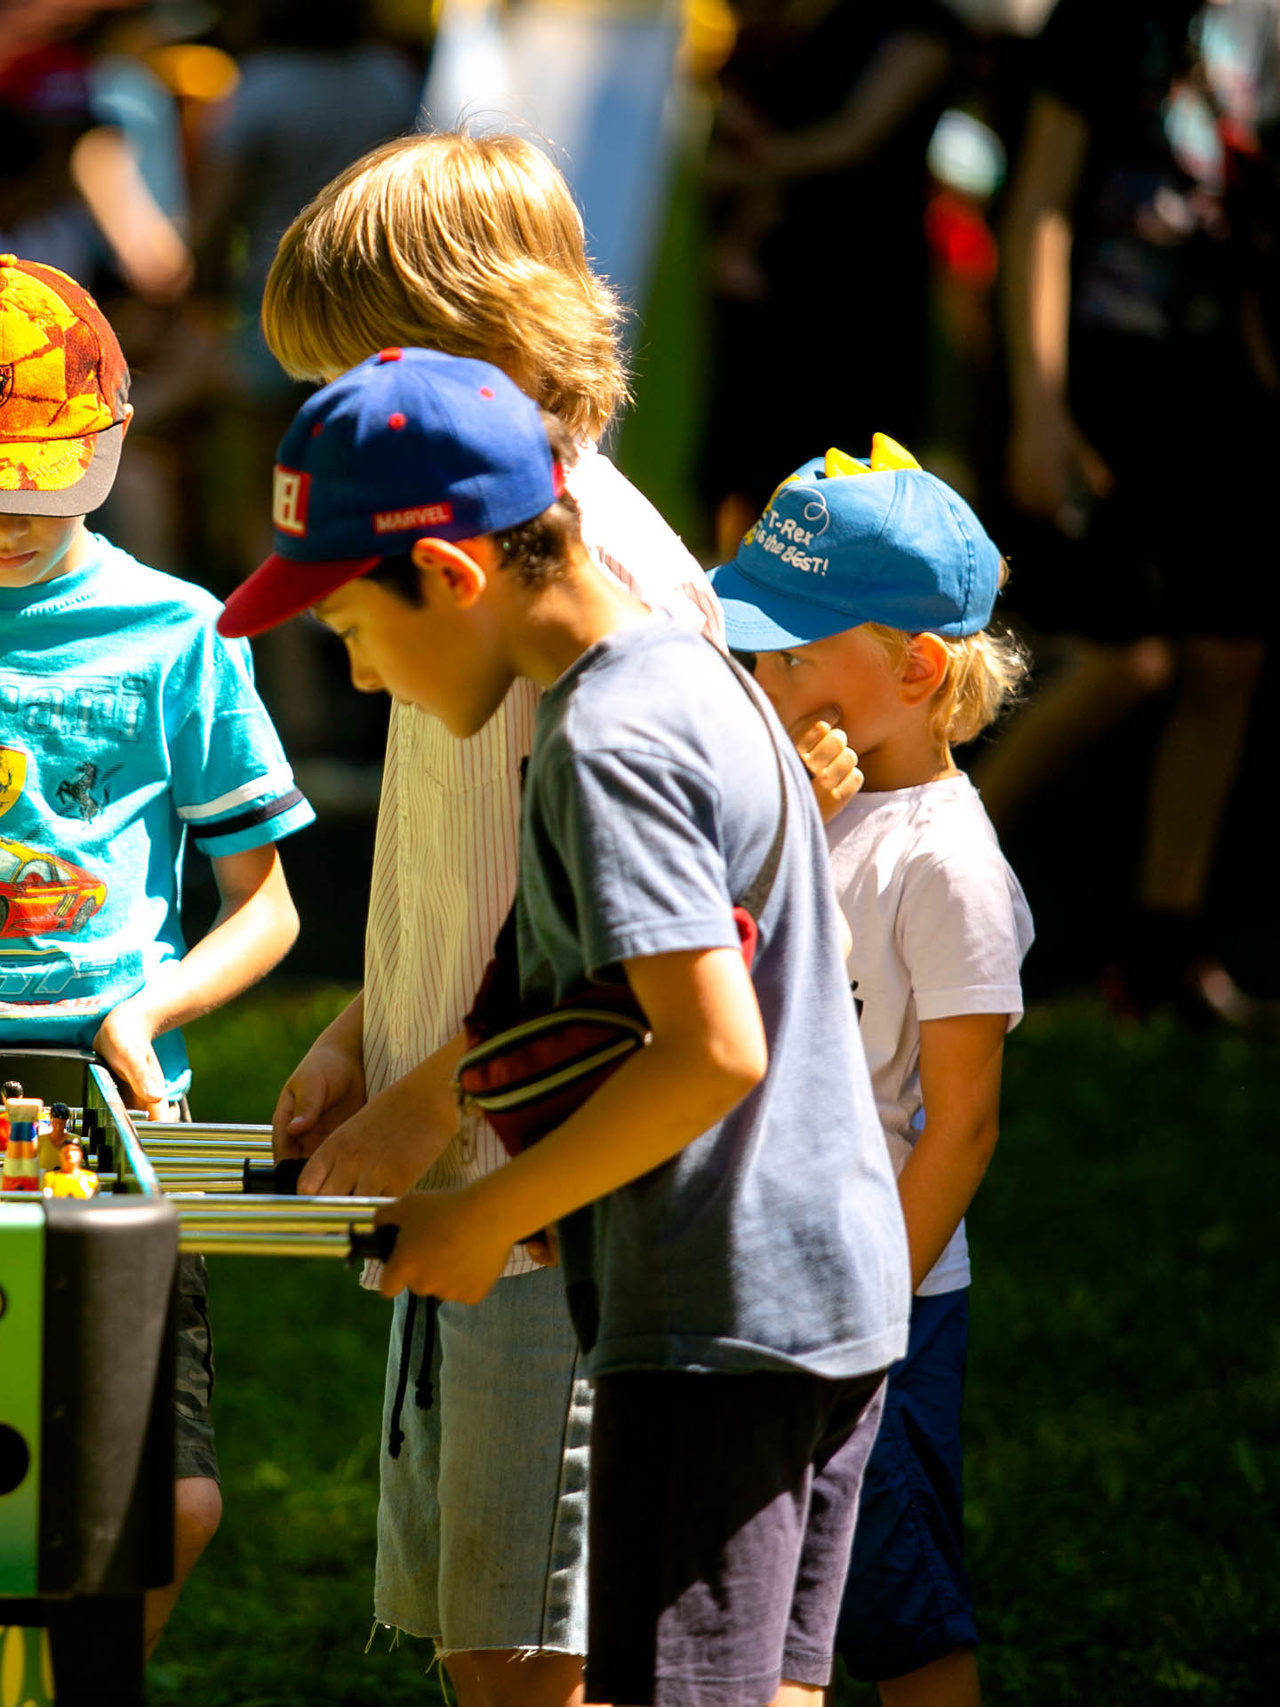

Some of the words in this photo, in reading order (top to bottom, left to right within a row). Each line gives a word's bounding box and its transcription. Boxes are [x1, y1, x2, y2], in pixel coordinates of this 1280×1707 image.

[375, 504, 450, 533] MARVEL
[768, 509, 815, 547] T-Rex
[763, 533, 786, 555] the
[781, 545, 830, 577] BEST!
